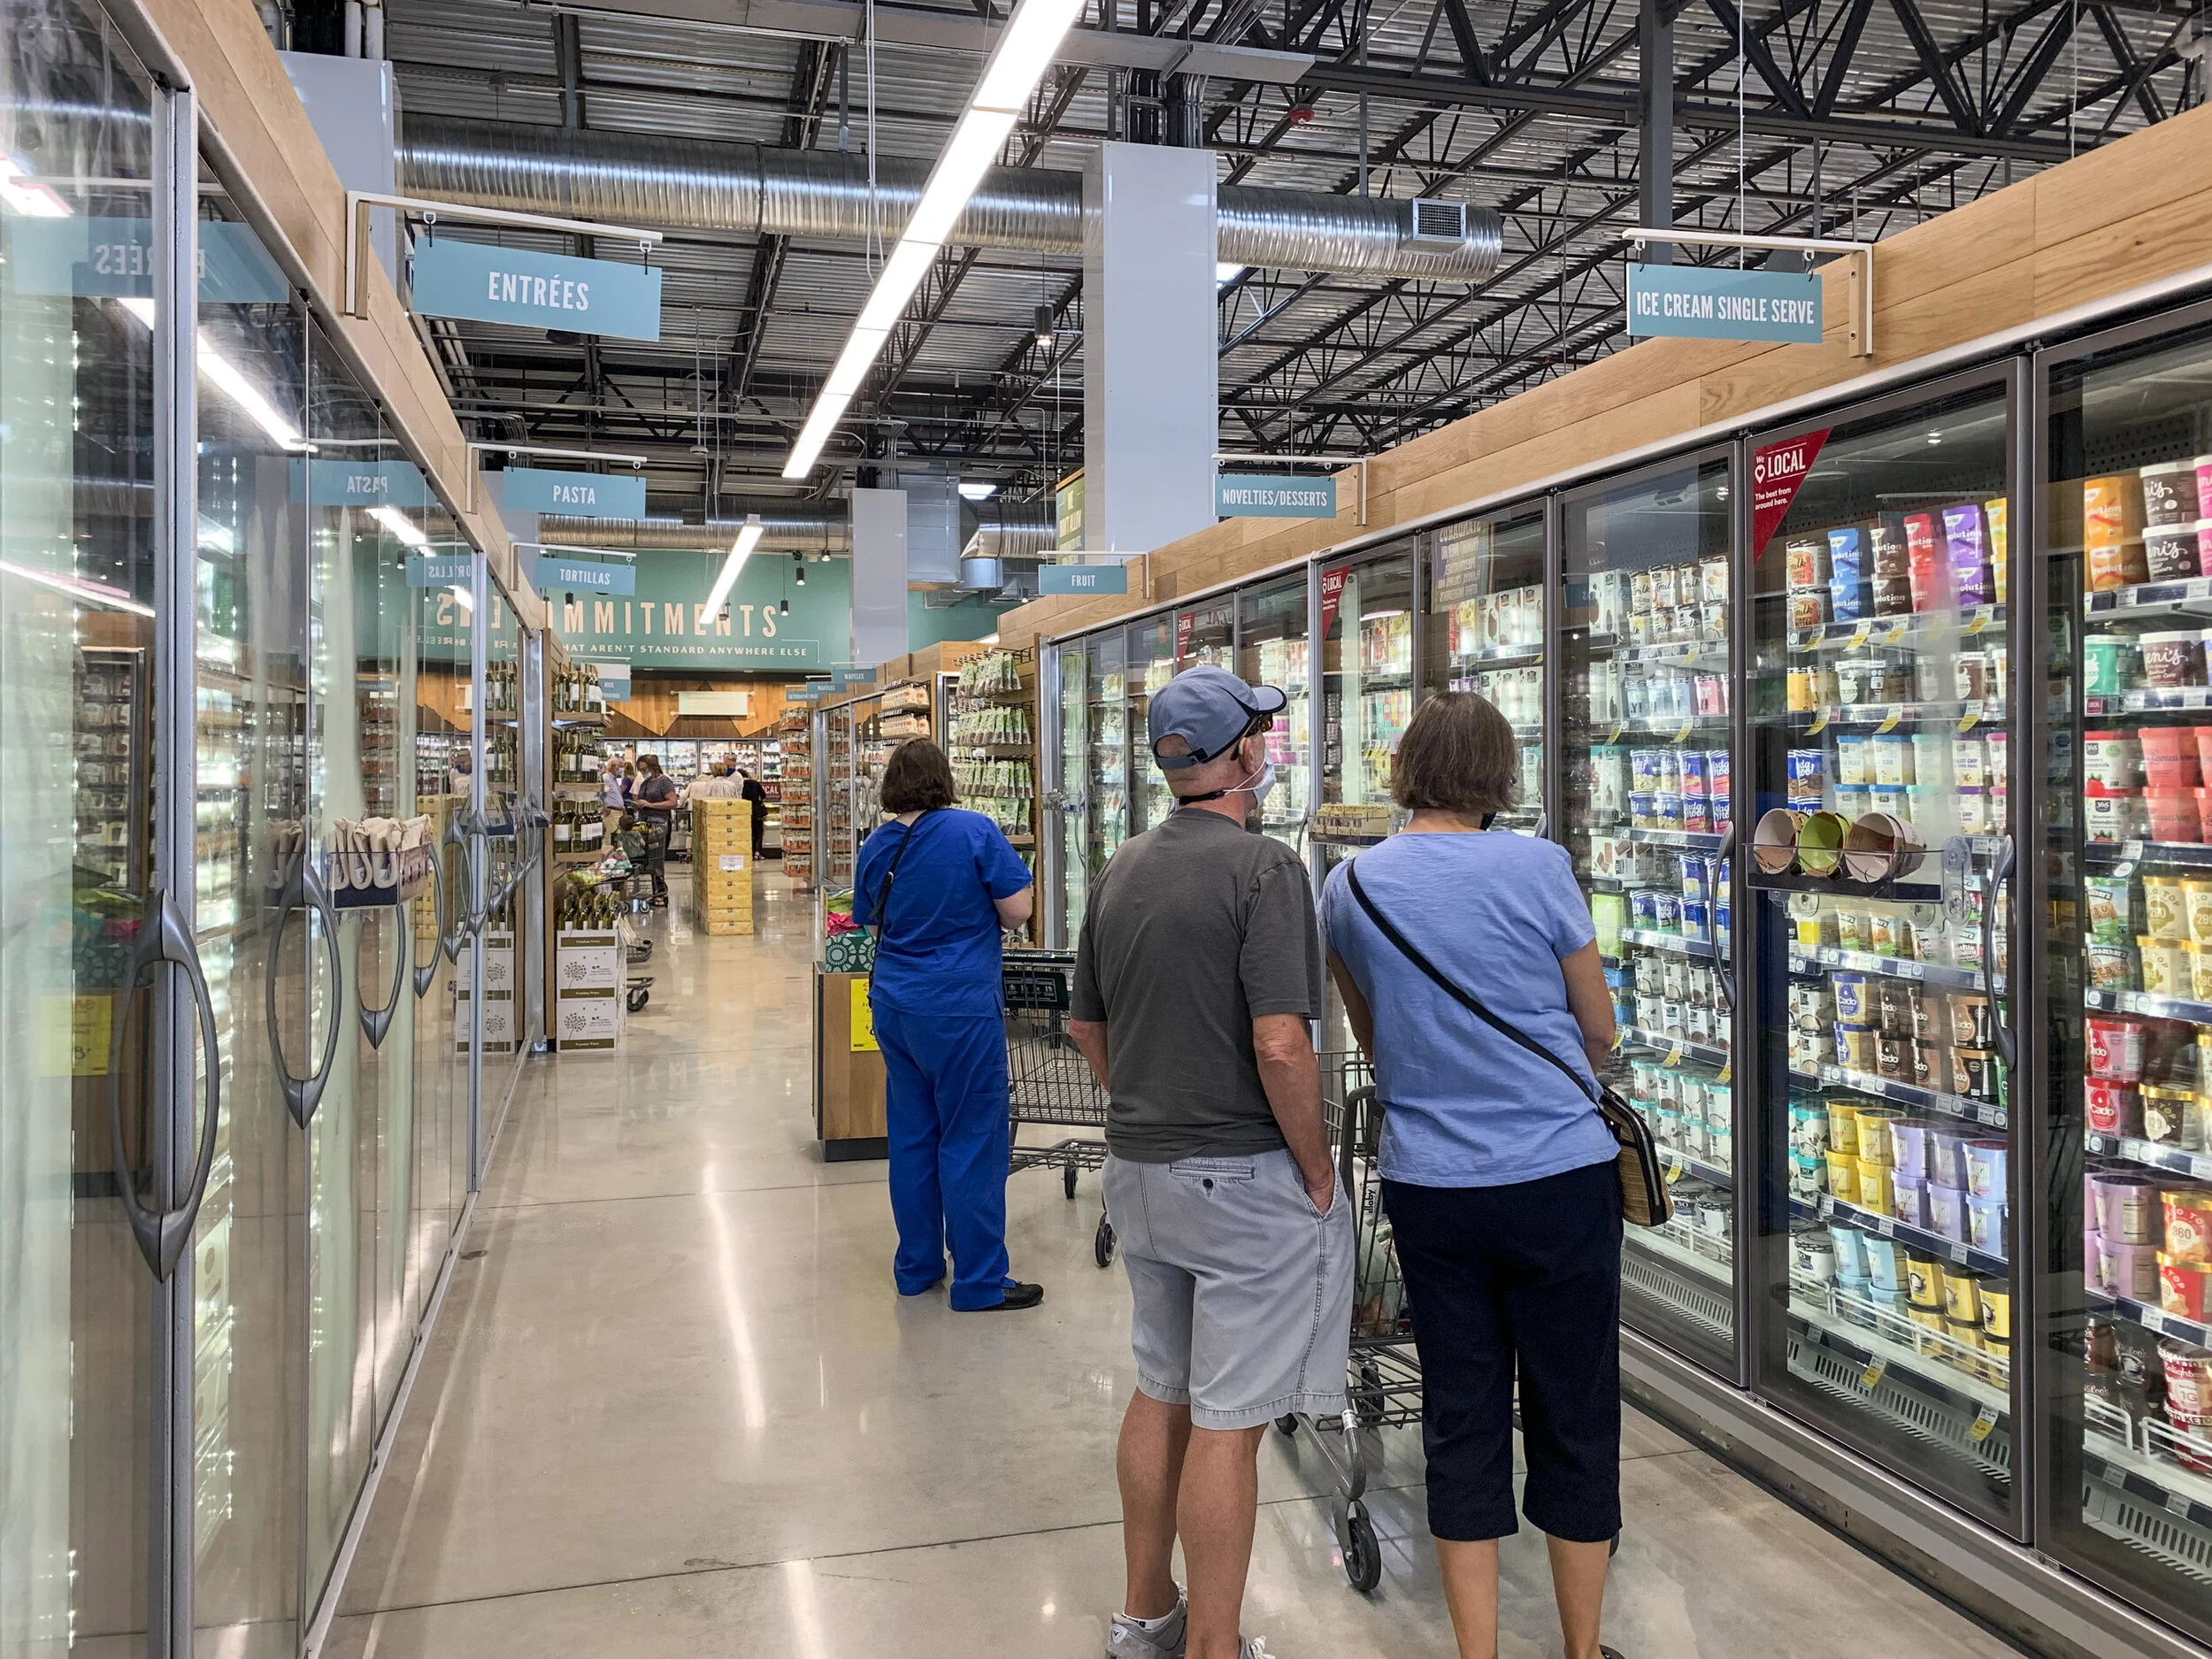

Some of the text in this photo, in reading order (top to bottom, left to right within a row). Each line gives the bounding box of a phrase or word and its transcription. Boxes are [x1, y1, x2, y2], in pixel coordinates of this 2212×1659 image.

[488, 272, 589, 311] ENTRÉES
[1637, 291, 1815, 325] ICE CREAM SINGLE SERVE
[1768, 449, 1806, 478] LOCAL
[553, 485, 595, 504] PASTA
[1223, 488, 1327, 507] NOVELTIES/DESSERTS
[1766, 489, 1778, 499] best
[1778, 488, 1791, 496] from
[1755, 497, 1788, 510] around here.
[559, 568, 611, 585] TORTILLAS
[1071, 574, 1096, 588] FRUIT
[1327, 575, 1342, 592] LOCAL
[590, 644, 635, 654] AREN'T
[640, 645, 704, 656] STANDARD
[710, 647, 775, 657] ANYWHERE
[780, 649, 807, 657] ELSE
[2089, 1104, 2116, 1116] Cado
[2172, 1225, 2193, 1240] 360
